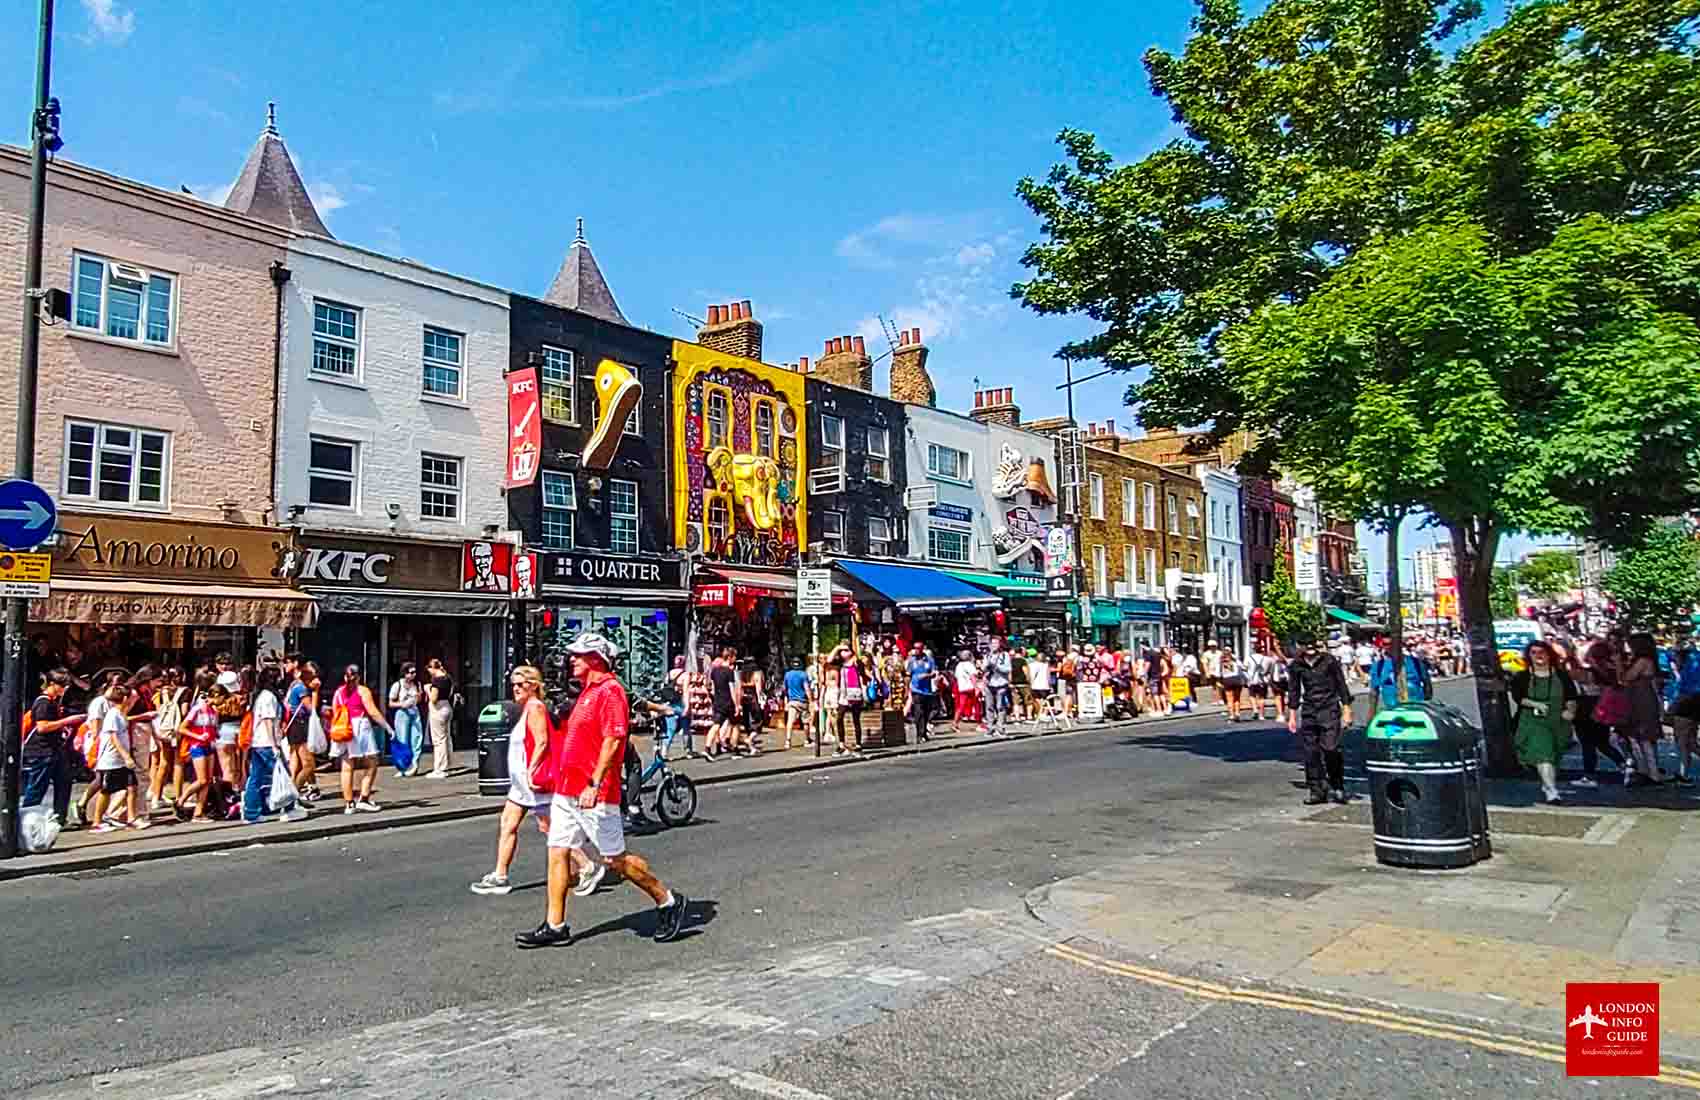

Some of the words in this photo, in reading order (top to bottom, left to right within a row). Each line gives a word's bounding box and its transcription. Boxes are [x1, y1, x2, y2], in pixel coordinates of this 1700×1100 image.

[511, 380, 534, 394] KFC
[64, 523, 240, 570] Amorino
[298, 548, 394, 583] KFC
[580, 559, 661, 582] QUARTER
[701, 589, 724, 601] ATM
[93, 602, 143, 614] GELATO
[161, 602, 224, 616] NATURALE
